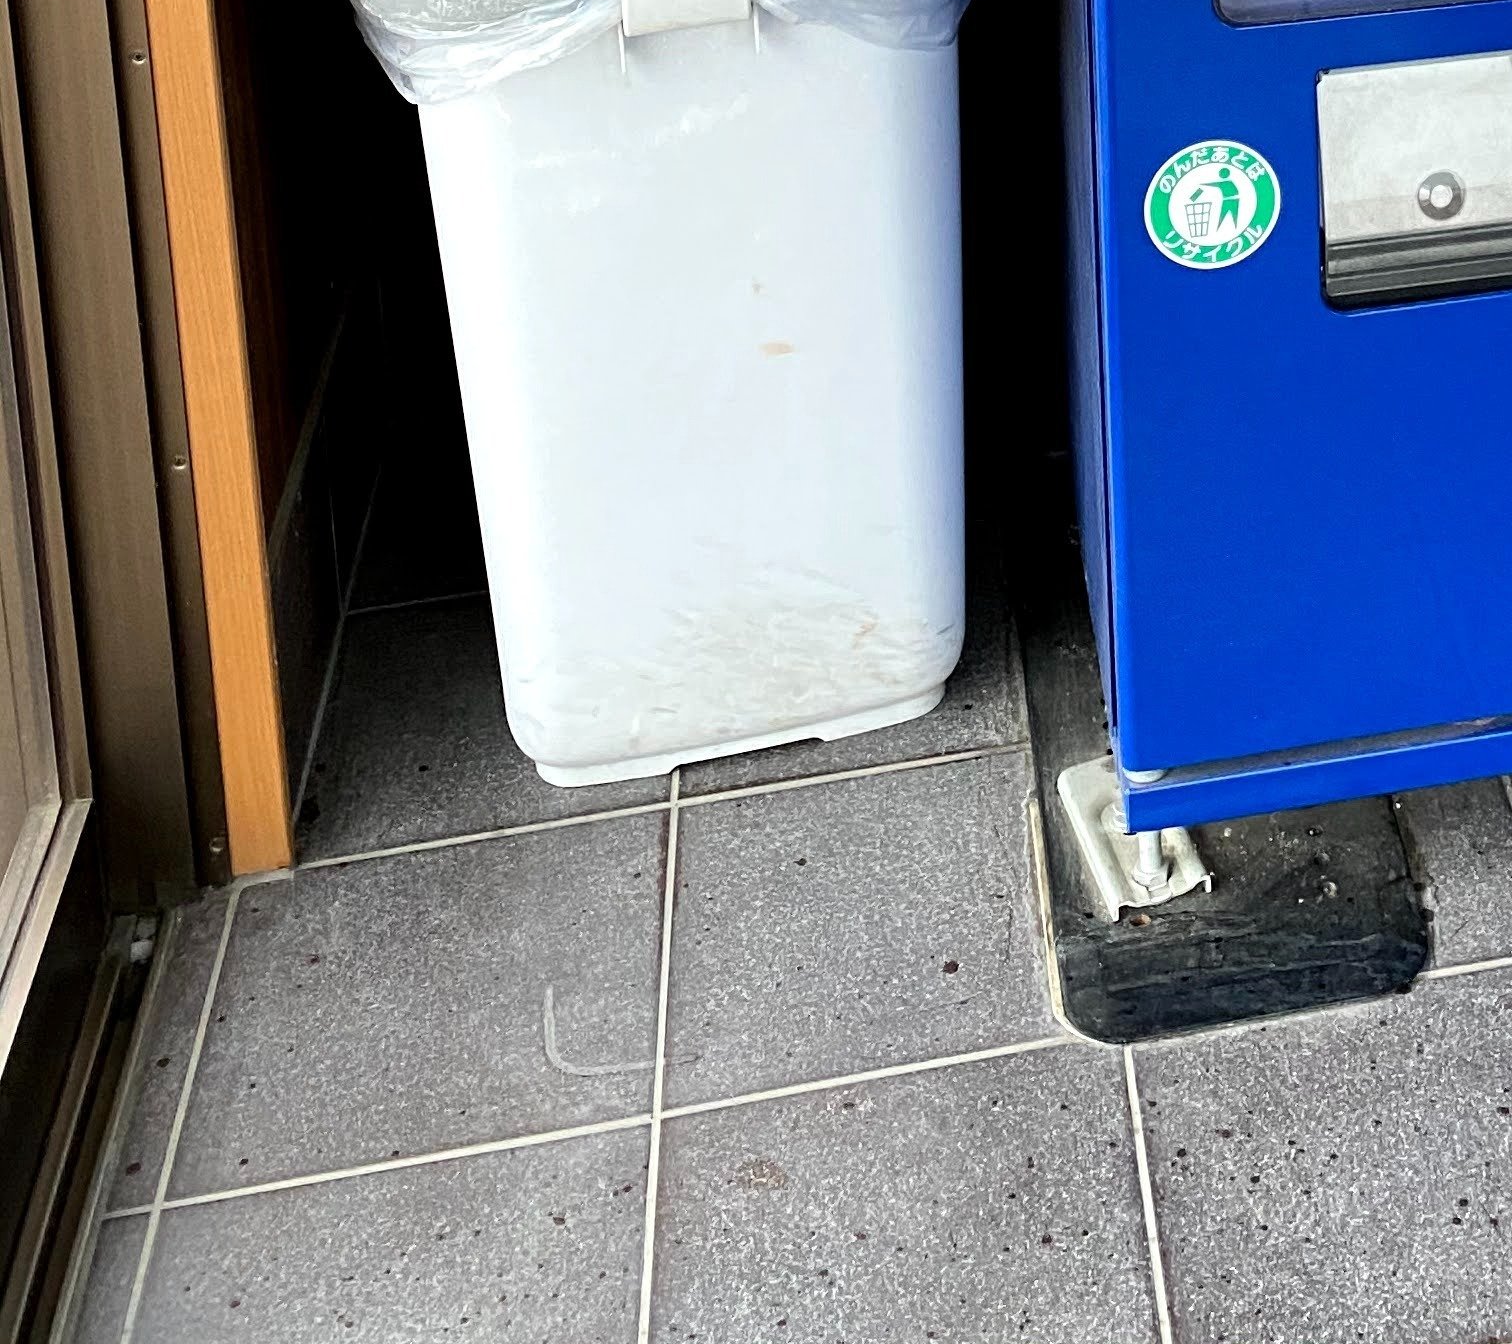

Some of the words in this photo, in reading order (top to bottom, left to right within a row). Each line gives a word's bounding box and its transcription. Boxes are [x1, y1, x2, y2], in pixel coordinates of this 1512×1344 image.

[1159, 147, 1265, 194] のんだあとは
[1163, 224, 1263, 263] リサイクル
